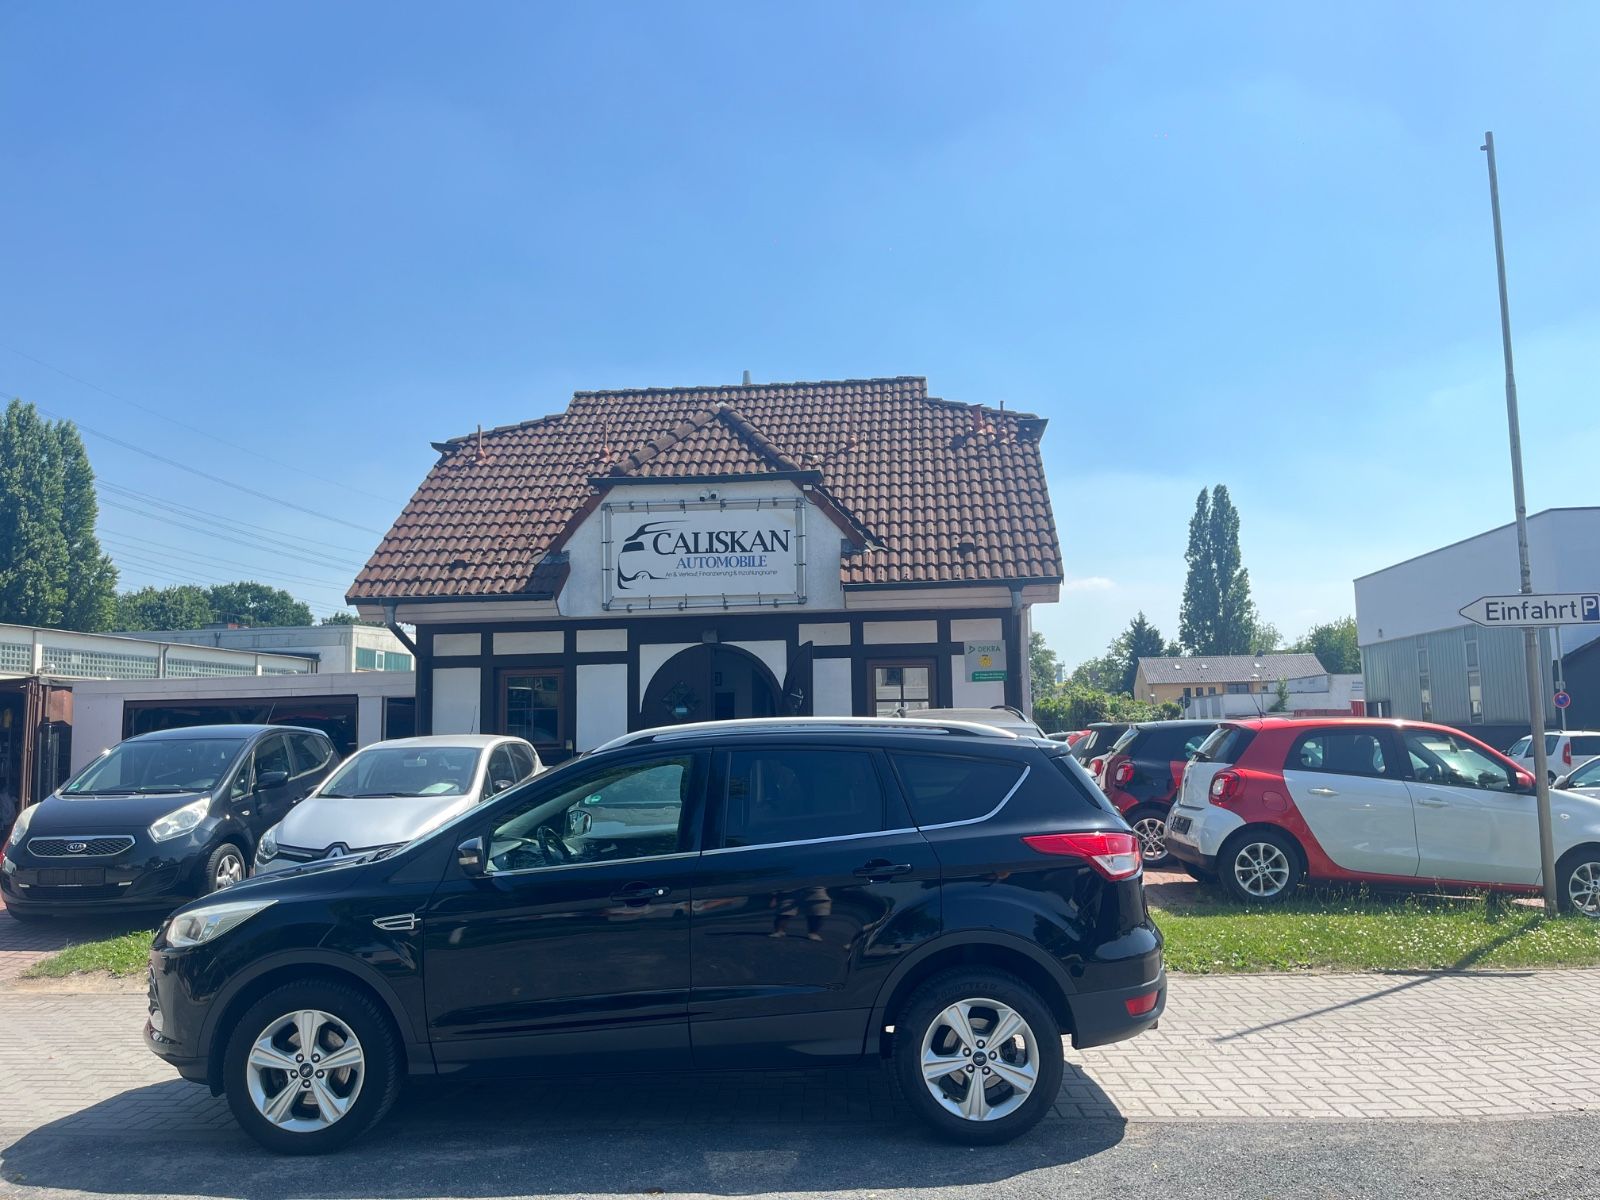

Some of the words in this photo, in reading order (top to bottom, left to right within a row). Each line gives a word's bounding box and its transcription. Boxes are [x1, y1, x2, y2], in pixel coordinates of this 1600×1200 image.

[652, 530, 791, 555] CALISKAN
[676, 555, 767, 569] AUTOMOBILE
[1485, 601, 1577, 620] Einfahrt
[1583, 598, 1597, 616] P
